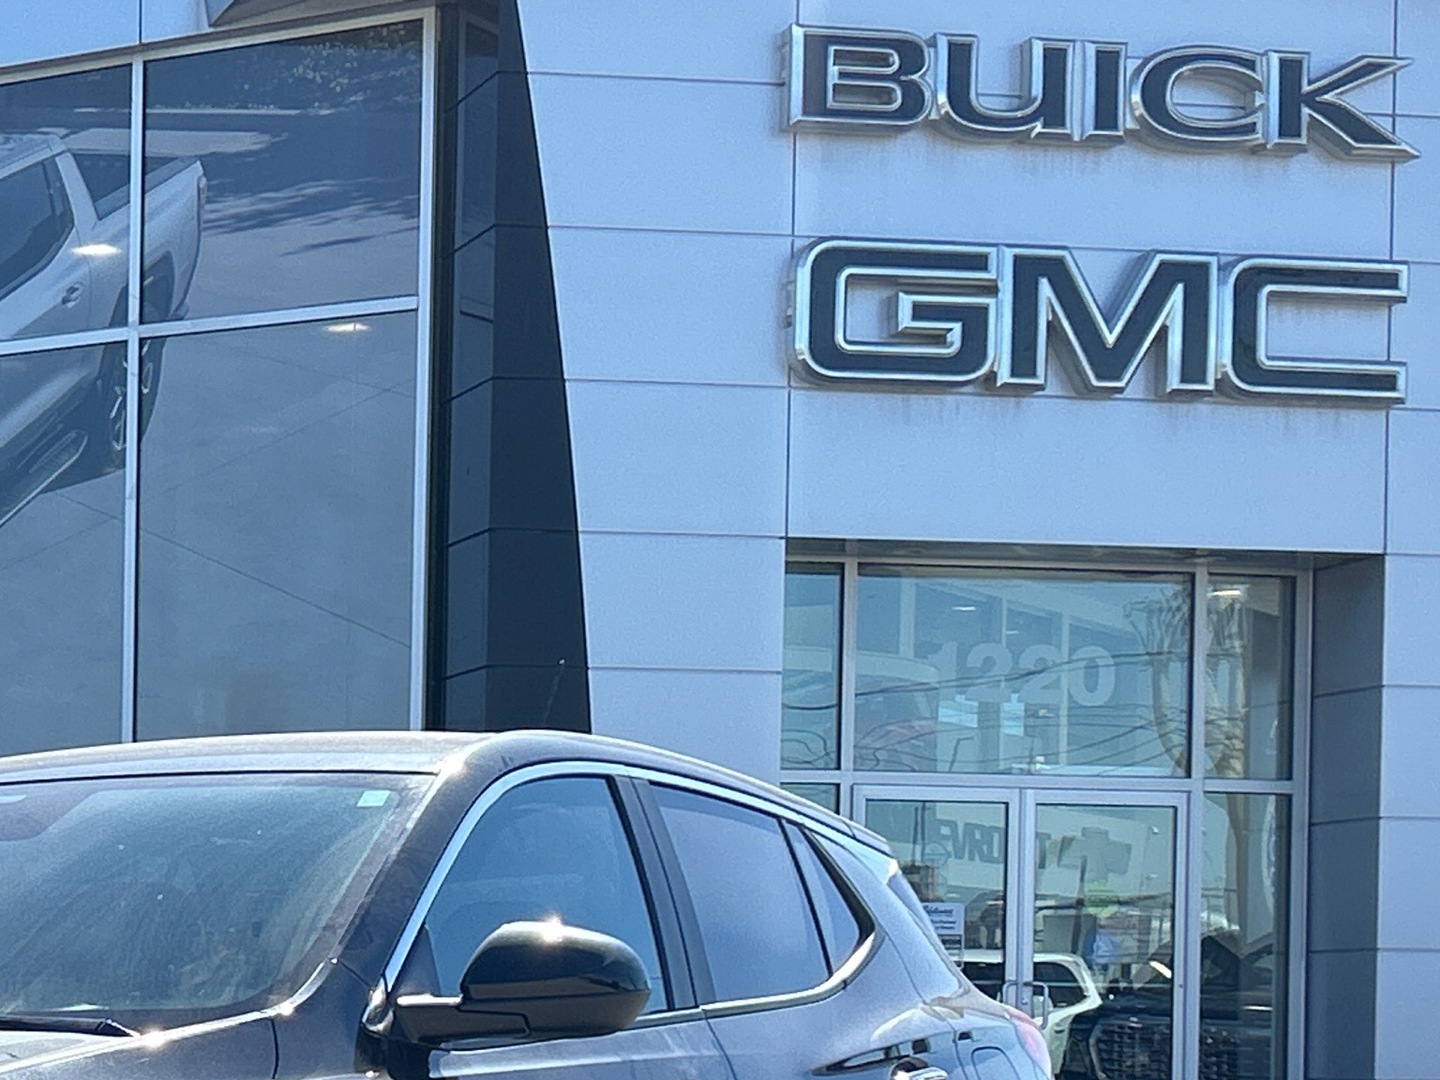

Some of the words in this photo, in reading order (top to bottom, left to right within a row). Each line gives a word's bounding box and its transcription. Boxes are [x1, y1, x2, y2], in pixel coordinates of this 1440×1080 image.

[786, 24, 1420, 162] BUICK
[794, 237, 1409, 405] GMC
[928, 642, 1115, 706] 1220
